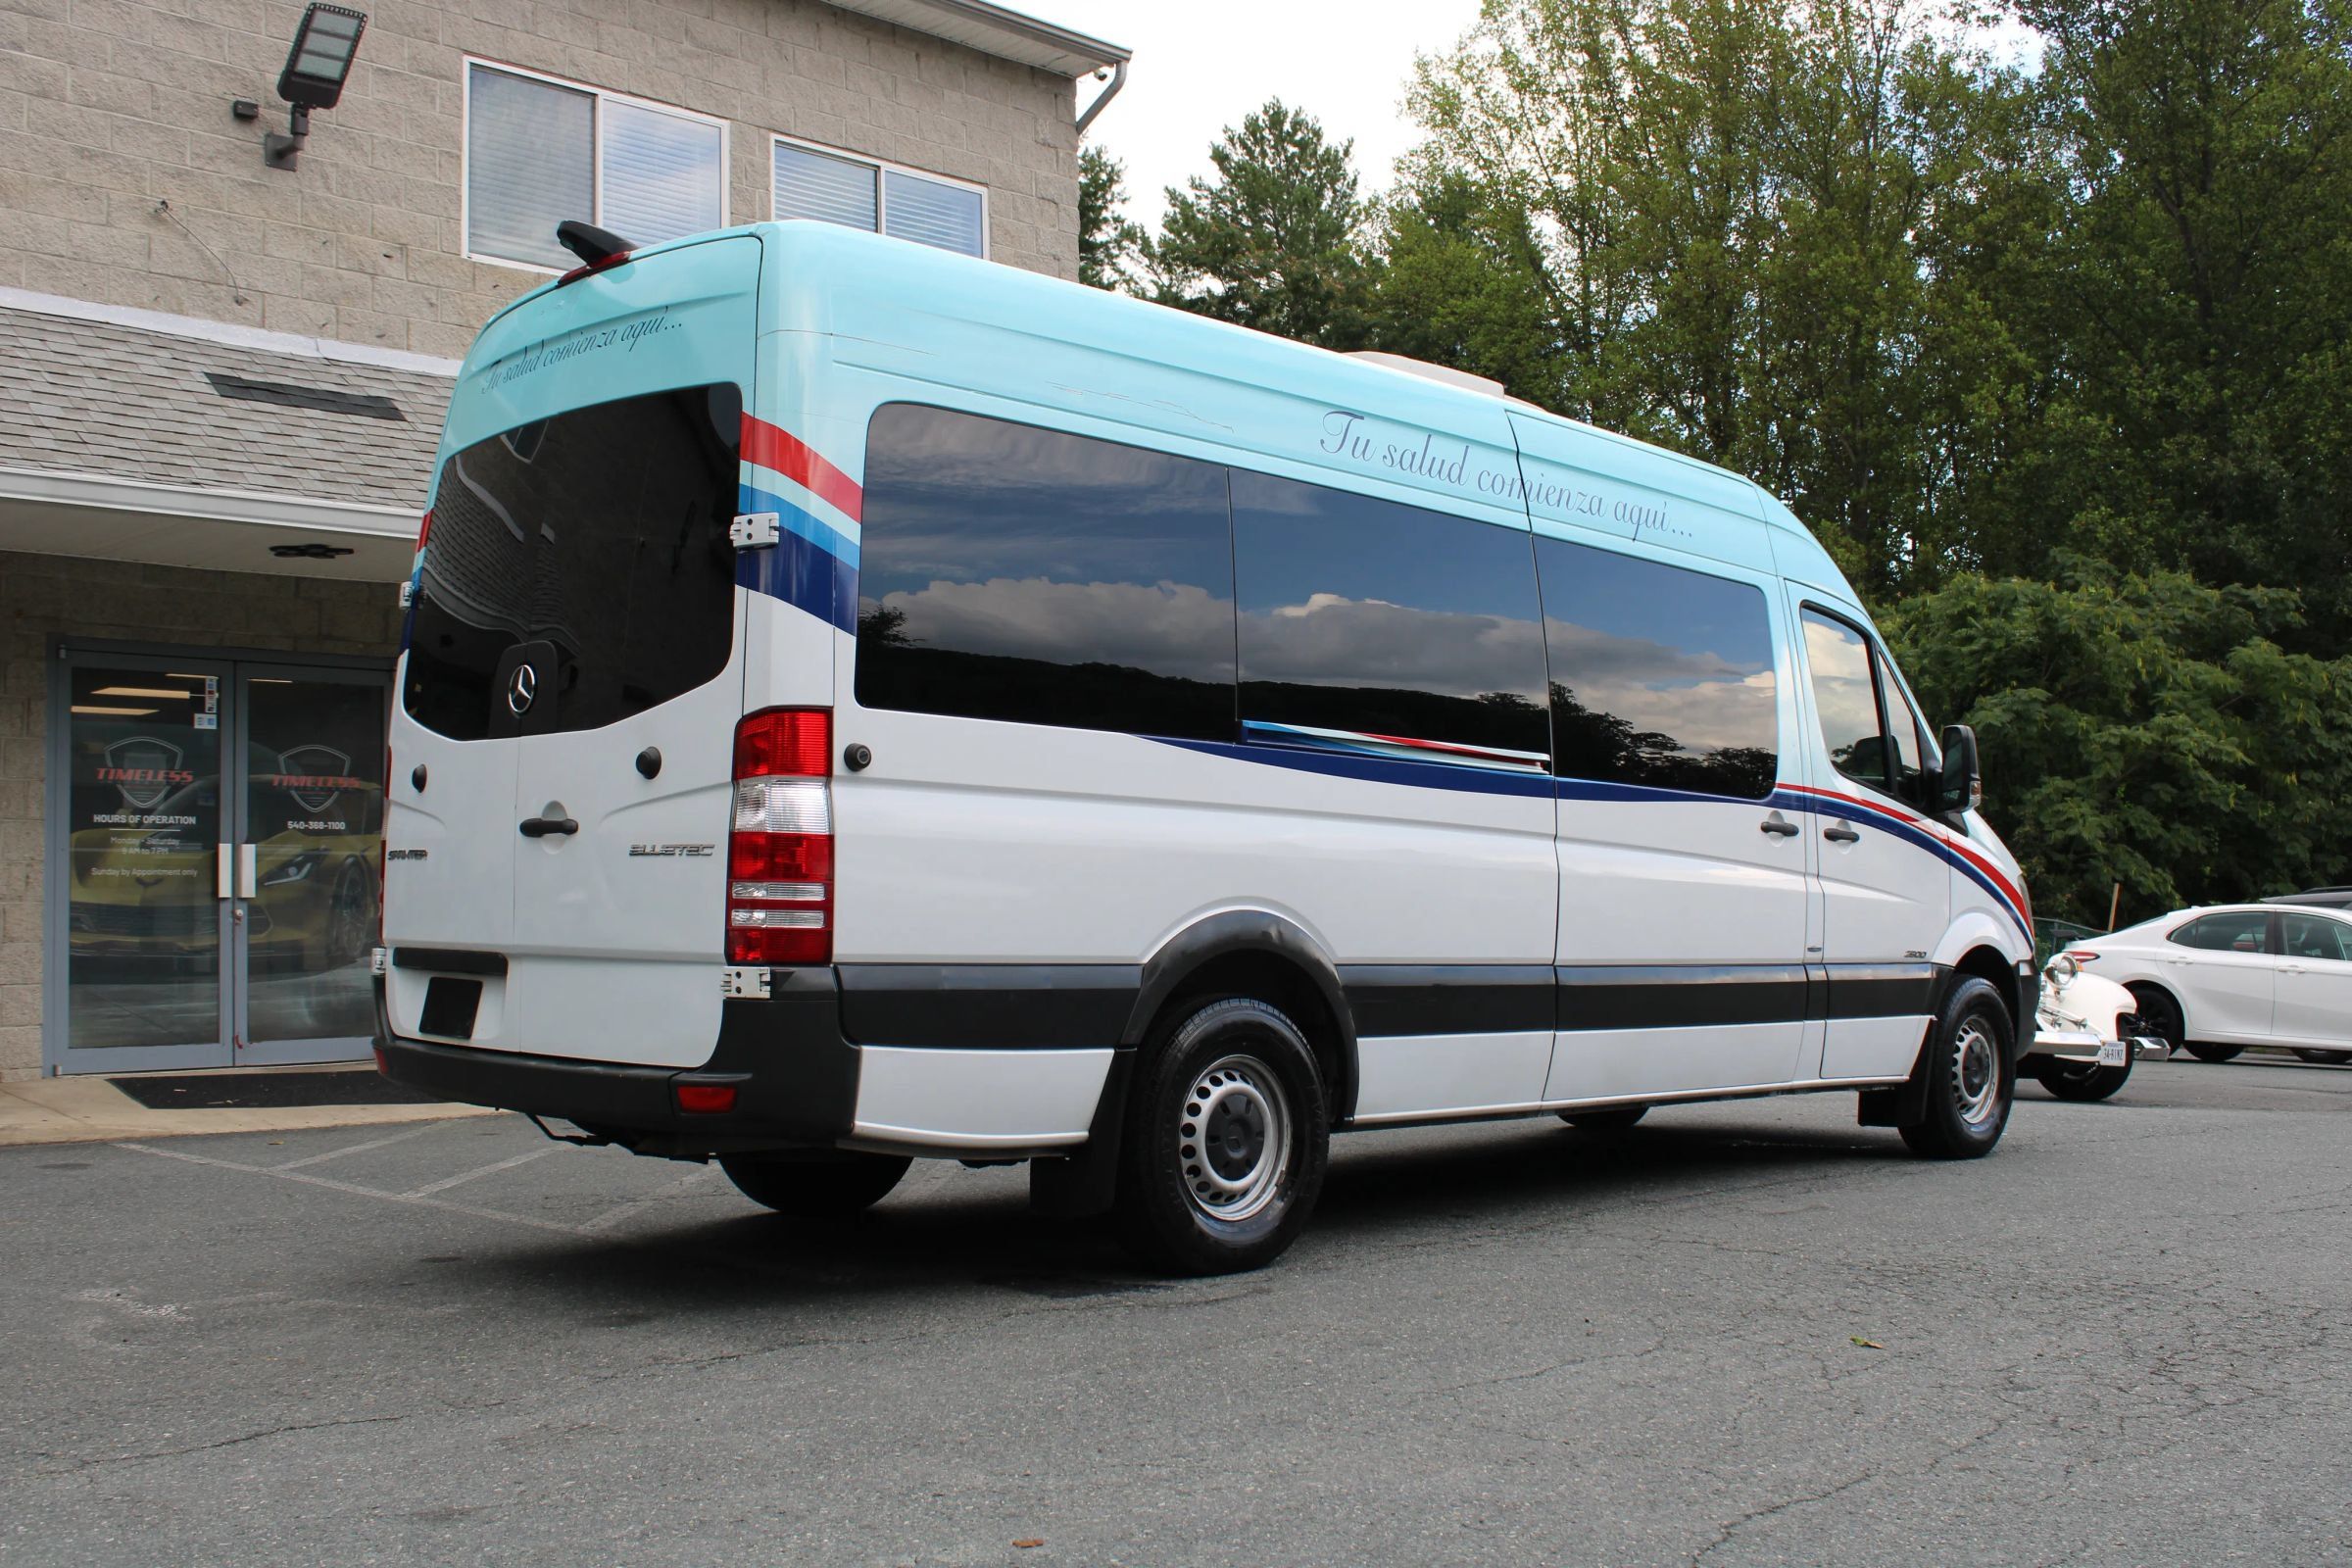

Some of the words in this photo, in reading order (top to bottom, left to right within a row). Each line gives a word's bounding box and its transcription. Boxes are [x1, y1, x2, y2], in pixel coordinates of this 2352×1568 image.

[503, 339, 545, 383] salud
[543, 328, 617, 368] comienza
[1320, 411, 1377, 462] Tu
[1383, 434, 1470, 486] salud
[1478, 469, 1608, 517] comienza
[96, 767, 194, 783] TIMELESS
[271, 774, 361, 789] TIMELESS
[93, 814, 126, 823] HOURS
[128, 814, 142, 823] OF
[142, 815, 197, 825] OPERATION
[91, 867, 120, 877] Sunday
[121, 867, 131, 877] by
[131, 868, 181, 878] Appointment
[182, 868, 198, 878] only
